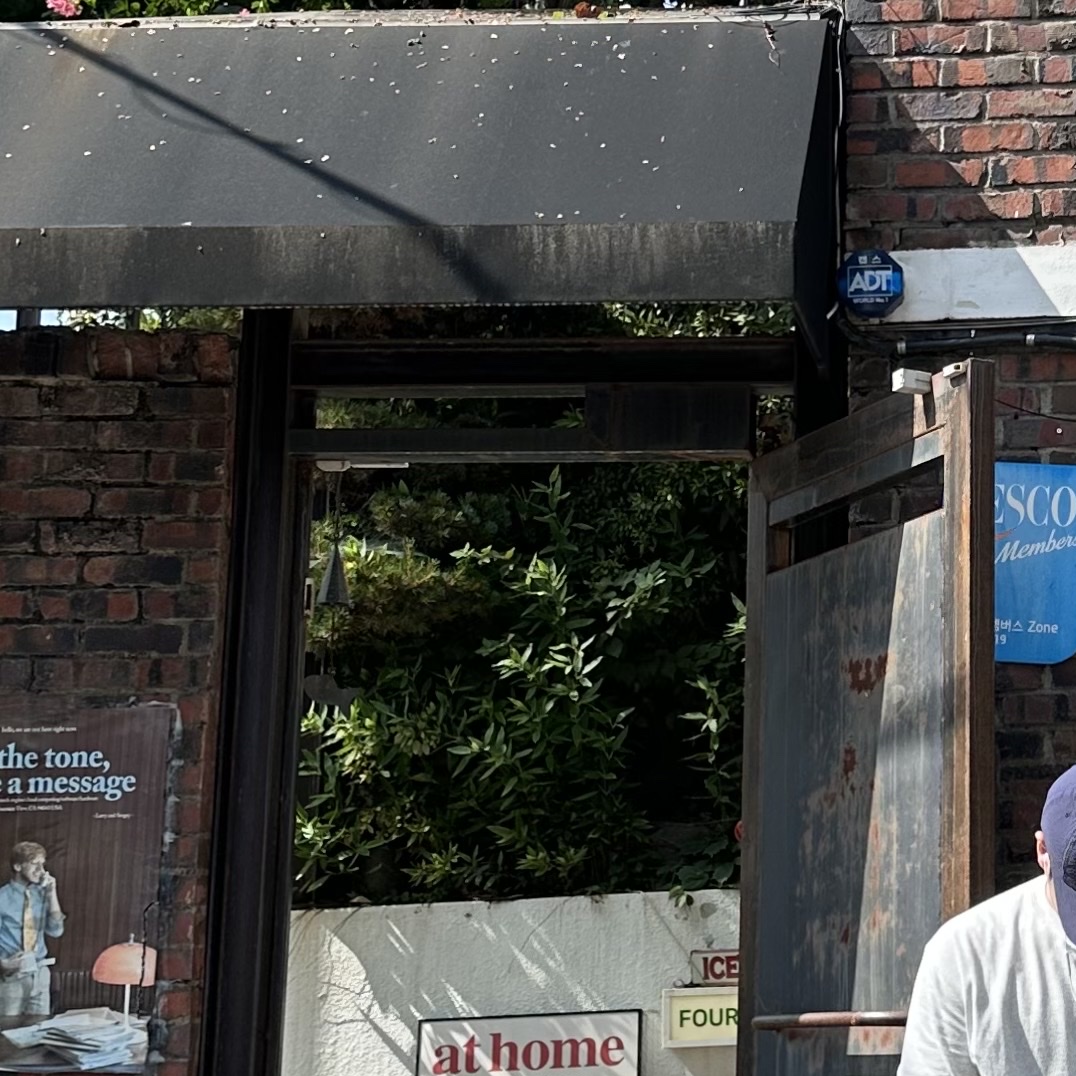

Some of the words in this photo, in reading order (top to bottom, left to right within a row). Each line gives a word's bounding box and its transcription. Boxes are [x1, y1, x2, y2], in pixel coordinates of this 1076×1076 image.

[848, 270, 892, 292] ADT
[1027, 620, 1059, 634] Zone
[0, 742, 39, 769] the
[44, 748, 111, 773] tone,
[7, 776, 23, 794] a
[27, 774, 137, 802] message
[702, 955, 740, 980] ICE
[679, 1008, 739, 1028] FOUR
[432, 1034, 482, 1075] at
[488, 1032, 625, 1073] home
